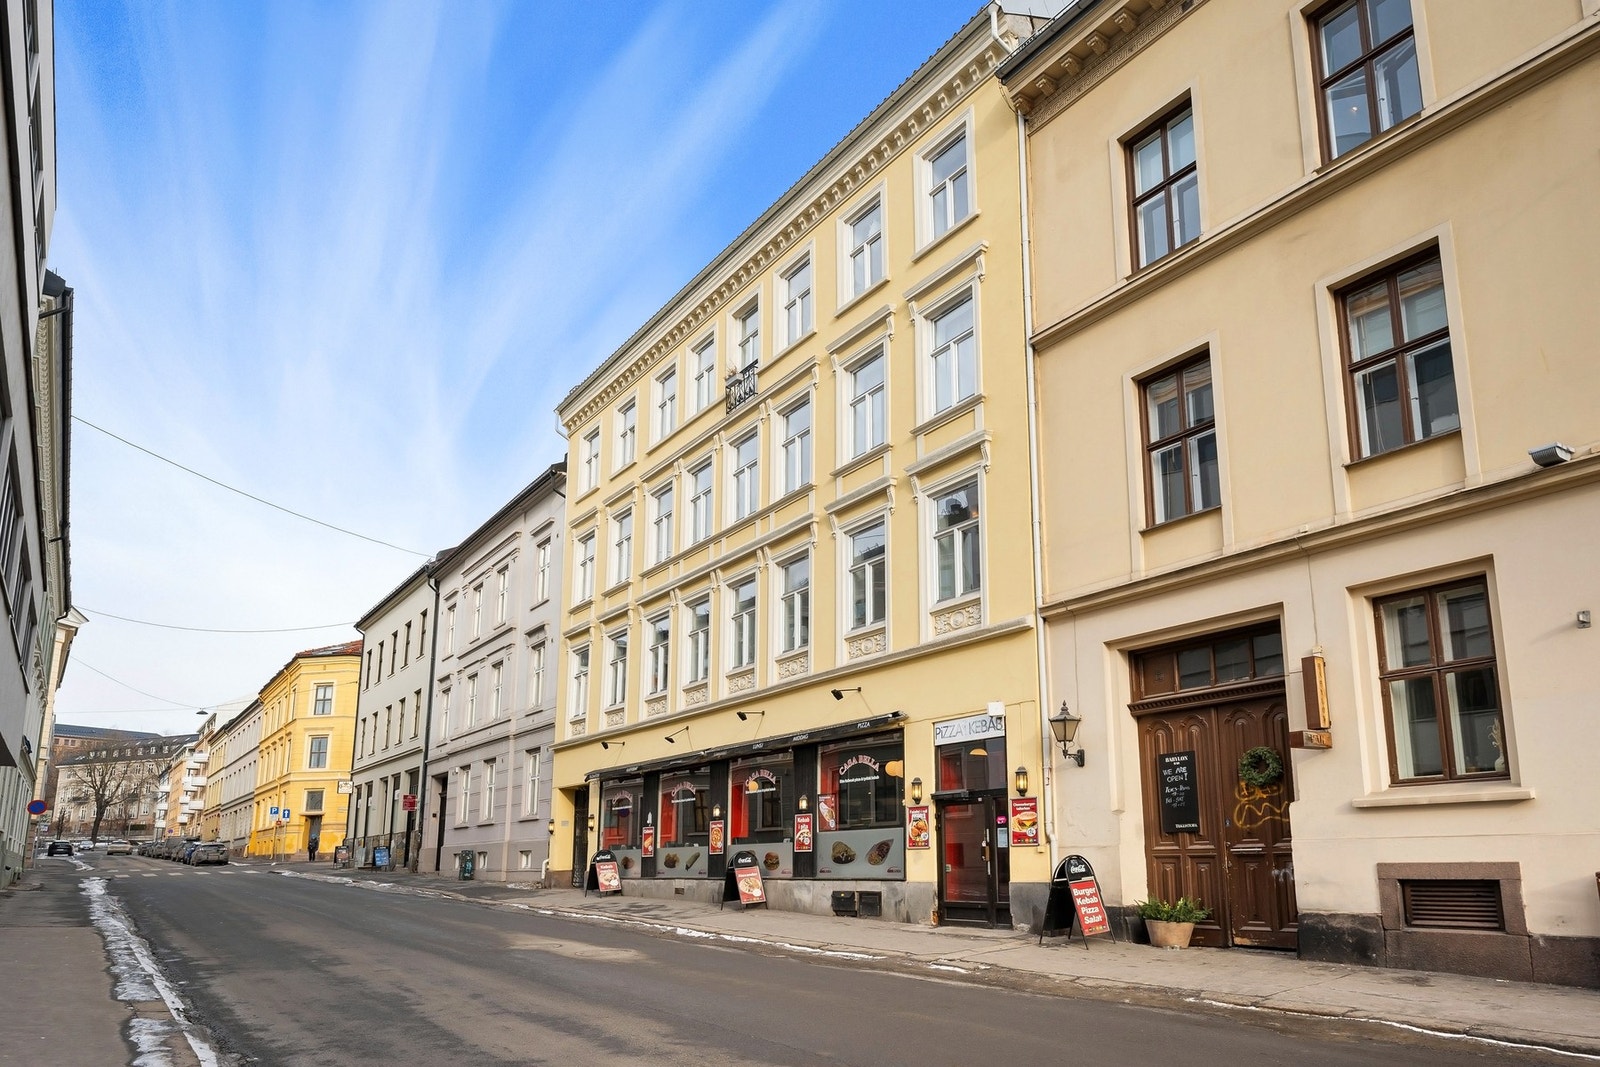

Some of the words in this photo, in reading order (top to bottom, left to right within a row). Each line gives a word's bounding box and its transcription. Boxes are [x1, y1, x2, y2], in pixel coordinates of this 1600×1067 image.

[968, 716, 1003, 736] KEBAB
[839, 757, 857, 776] CASA
[858, 755, 880, 772] BELLA
[1162, 768, 1172, 776] WE
[1175, 766, 1187, 774] ARE
[1073, 887, 1096, 897] Burger
[1076, 896, 1098, 905] Kebab
[1081, 906, 1099, 914] Pizza
[1084, 915, 1103, 925] Salat
